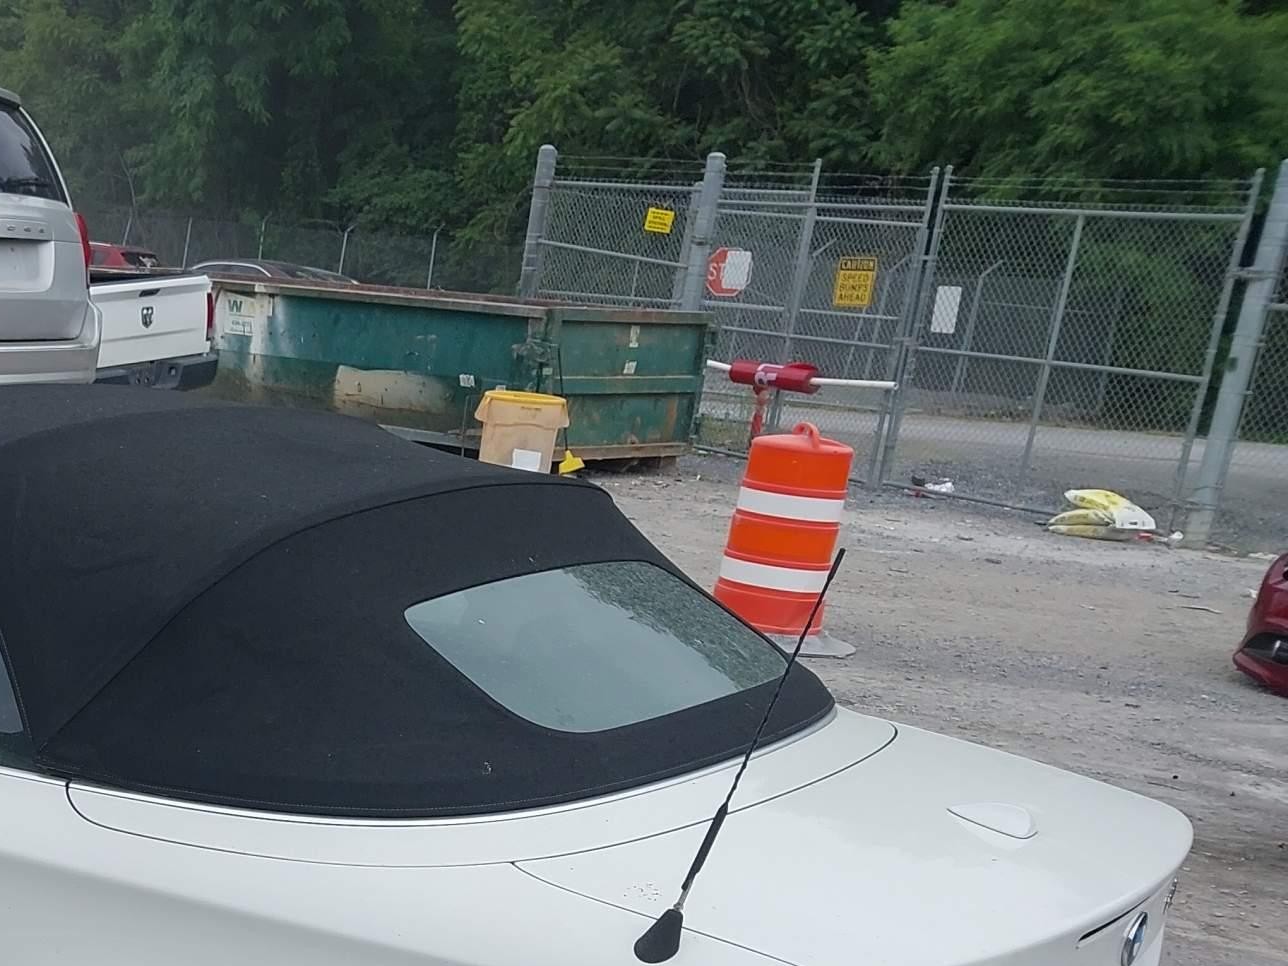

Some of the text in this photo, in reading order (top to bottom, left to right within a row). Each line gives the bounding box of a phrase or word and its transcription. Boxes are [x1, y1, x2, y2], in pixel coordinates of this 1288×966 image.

[708, 262, 726, 280] ST
[841, 272, 870, 282] SPEED
[838, 293, 866, 302] AHEAD
